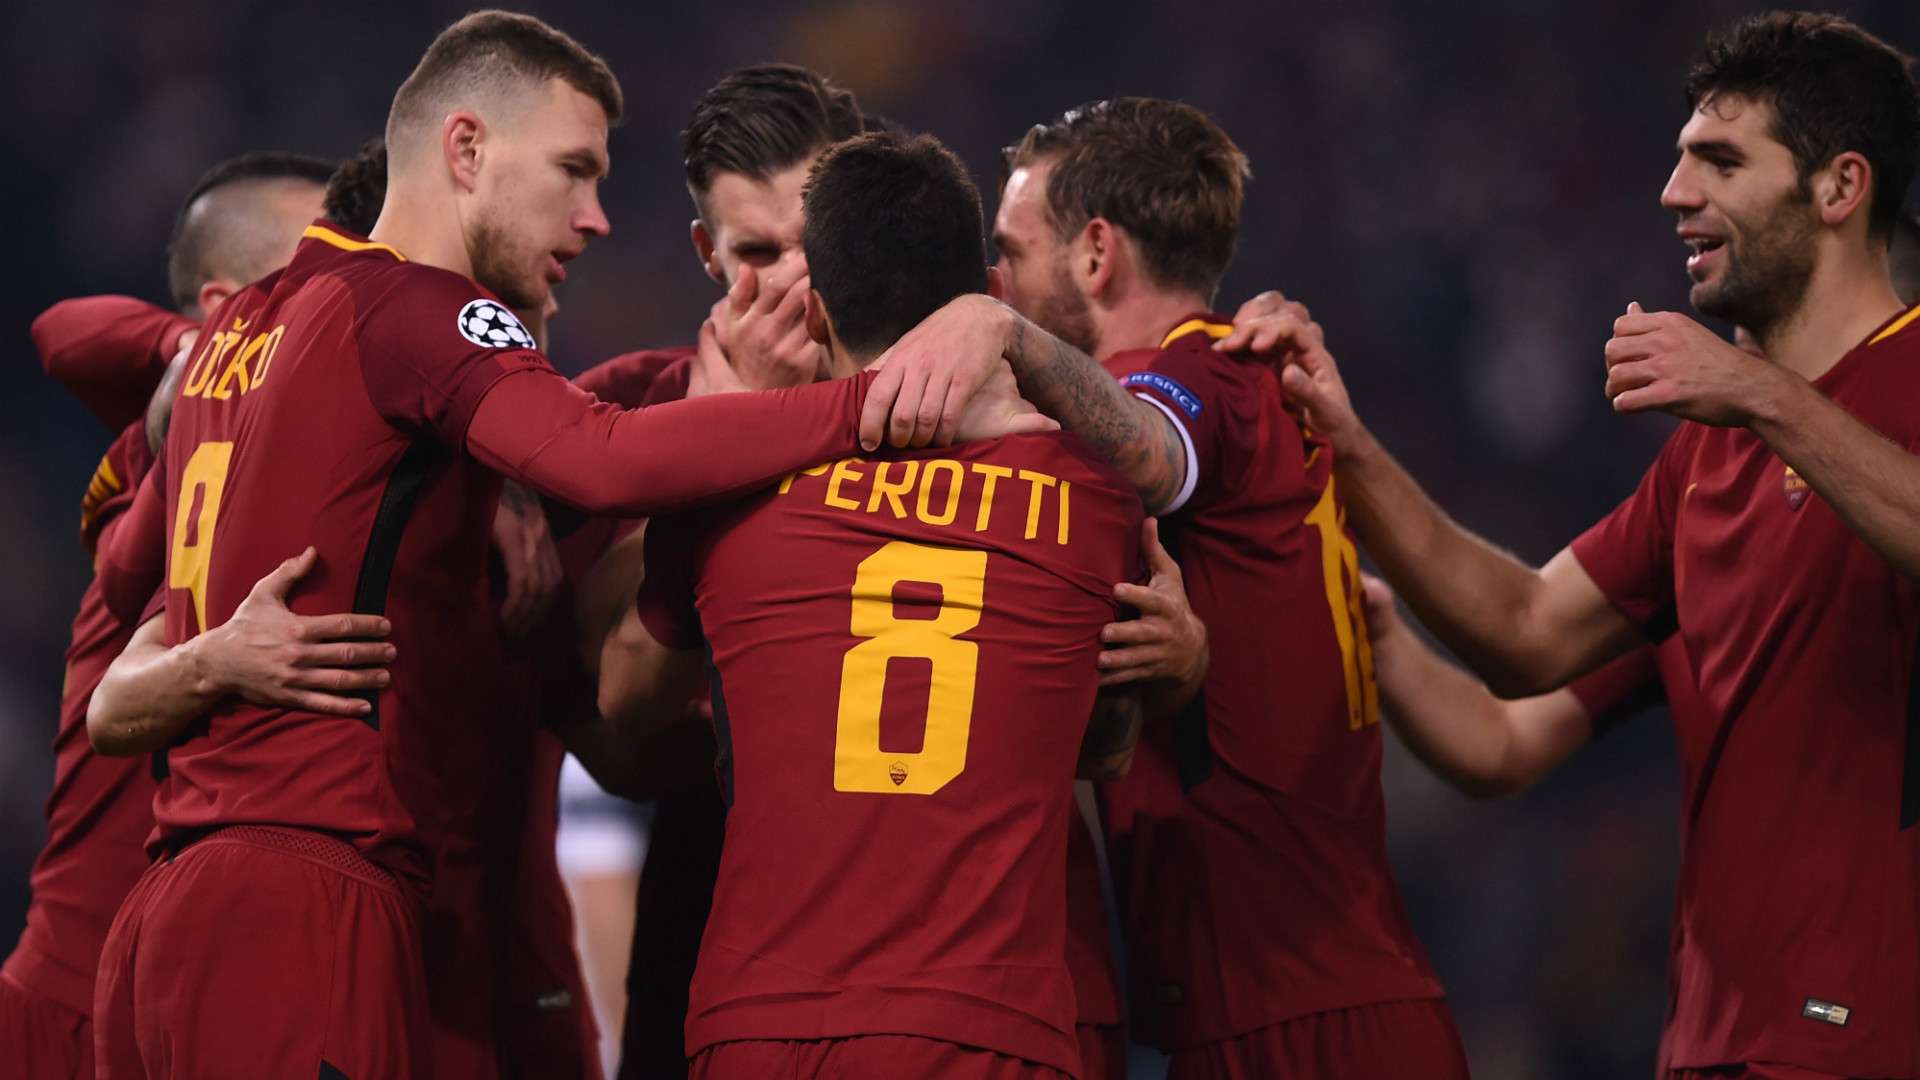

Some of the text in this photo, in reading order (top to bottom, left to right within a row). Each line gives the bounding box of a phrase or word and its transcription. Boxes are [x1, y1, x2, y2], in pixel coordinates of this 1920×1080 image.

[1130, 374, 1200, 413] RESPECT
[169, 441, 234, 634] 9
[833, 540, 988, 796] 8
